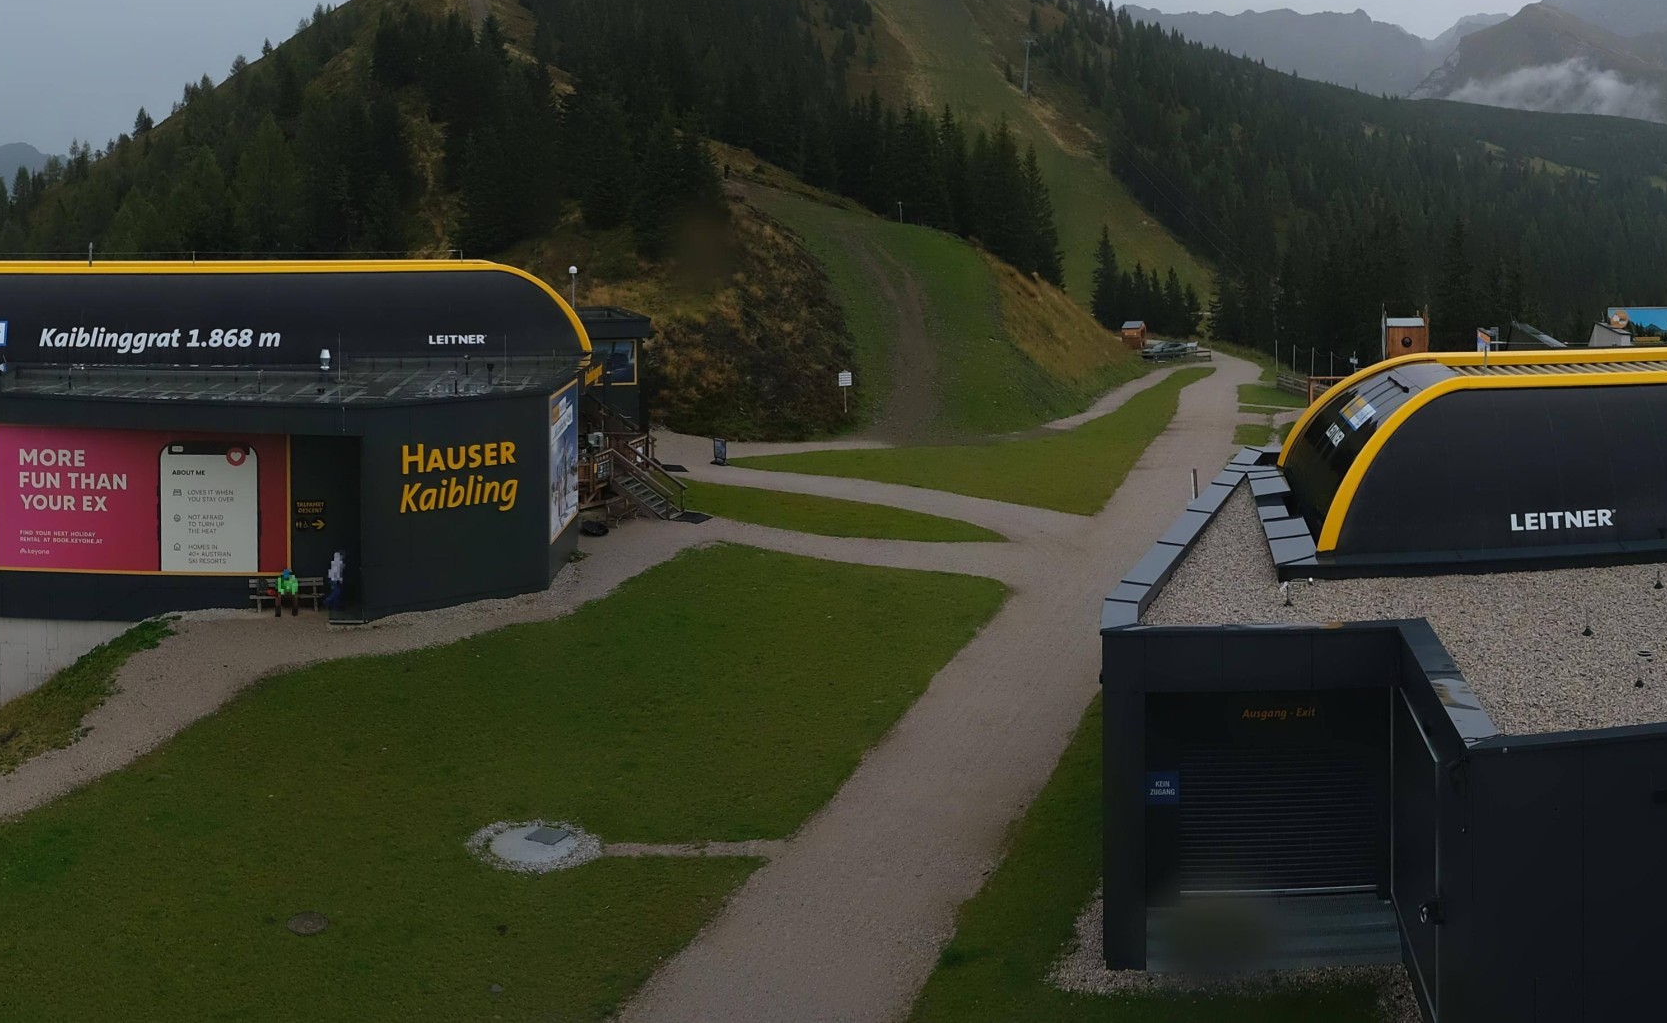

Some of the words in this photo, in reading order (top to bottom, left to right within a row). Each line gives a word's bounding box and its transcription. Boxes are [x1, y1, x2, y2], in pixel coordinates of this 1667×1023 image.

[39, 327, 181, 354] Kaiblinggrat
[186, 328, 253, 348] 1.868
[258, 331, 281, 347] m
[428, 334, 486, 345] LEITNER
[19, 448, 86, 467] MORE
[402, 441, 517, 475] HAUSER
[19, 471, 60, 489] FUN
[67, 473, 127, 490] THAN
[20, 494, 76, 511] YOUR
[82, 496, 108, 512] EX
[400, 475, 519, 514] Kaibling
[1510, 509, 1614, 531] LEITNER
[28, 548, 50, 556] keyone
[1241, 708, 1288, 721] Ausgang
[1296, 707, 1316, 717] Exit
[1149, 788, 1175, 796] ZUGANG
[1155, 780, 1170, 788] KEIN
